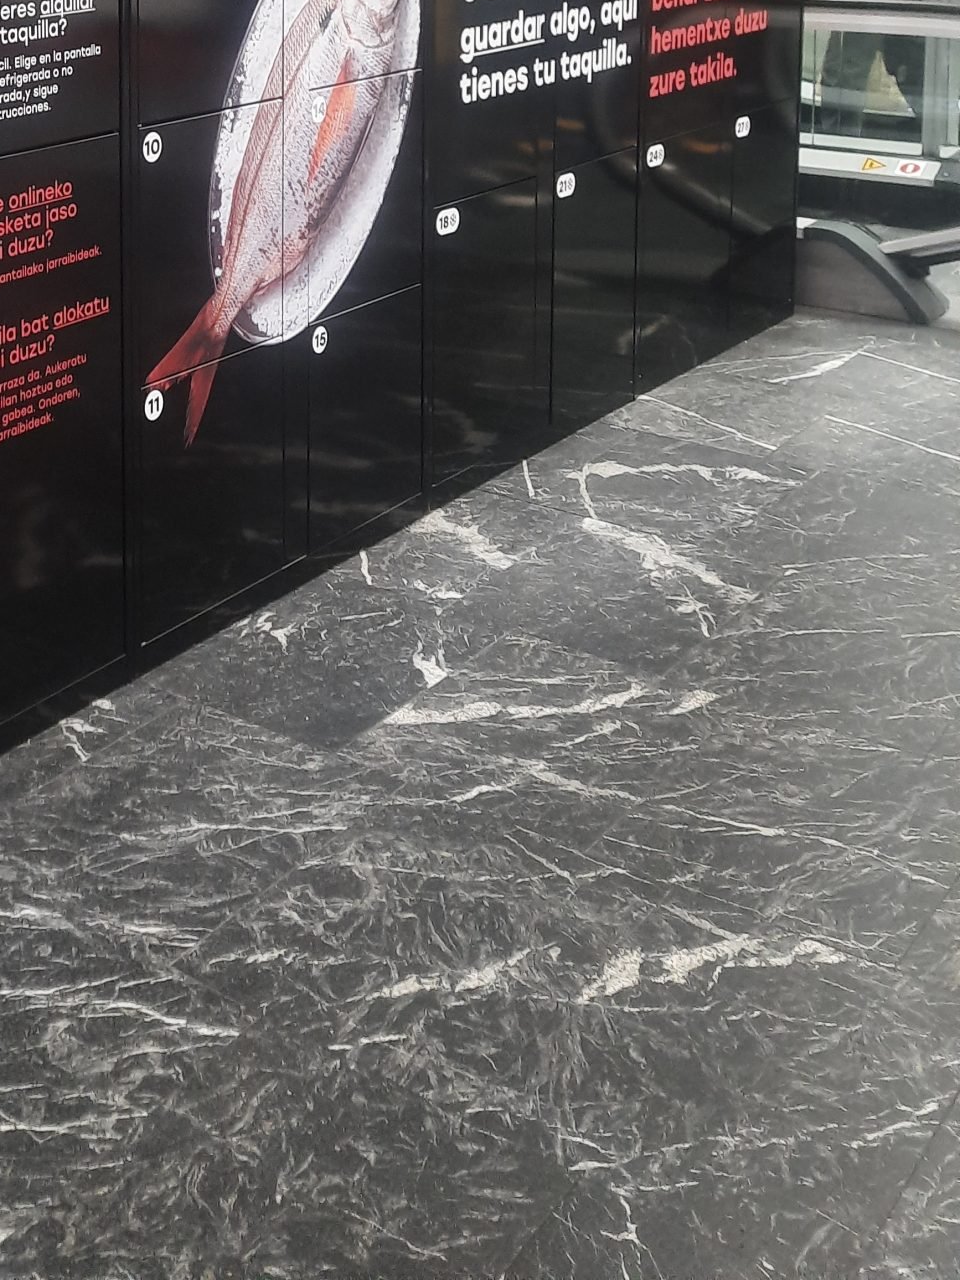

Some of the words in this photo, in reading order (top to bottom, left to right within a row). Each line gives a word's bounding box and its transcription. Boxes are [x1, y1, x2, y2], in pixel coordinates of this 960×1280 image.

[0, 18, 68, 47] taquilla?
[460, 10, 545, 64] guardar
[550, 2, 596, 43] algo,
[651, 18, 731, 55] hementxe
[734, 7, 768, 36] duzu
[15, 53, 37, 69] Elige
[39, 53, 51, 64] en
[53, 50, 62, 62] la
[64, 43, 101, 64] pantalla
[52, 68, 60, 78] o
[61, 65, 73, 77] no
[460, 65, 529, 105] tienes
[533, 57, 556, 87] tu
[560, 37, 632, 84] taquilla.
[649, 67, 686, 98] zure
[689, 51, 737, 87] takila.
[33, 82, 59, 99] sigue
[145, 139, 159, 156] 10
[8, 179, 73, 213] onlineko
[46, 203, 78, 229] jaso
[8, 230, 54, 257] duzu?
[46, 245, 103, 274] jarraibideak.
[21, 313, 49, 337] bat
[53, 296, 110, 330] alokatu
[9, 334, 55, 365] duzu?
[315, 332, 326, 347] 15
[27, 369, 43, 383] da.
[45, 353, 87, 377] Aukeratu
[19, 382, 53, 402] hoztua
[55, 373, 73, 389] edo
[2, 404, 36, 426] gabea.
[38, 387, 81, 410] Ondoren,
[148, 397, 160, 414] 11
